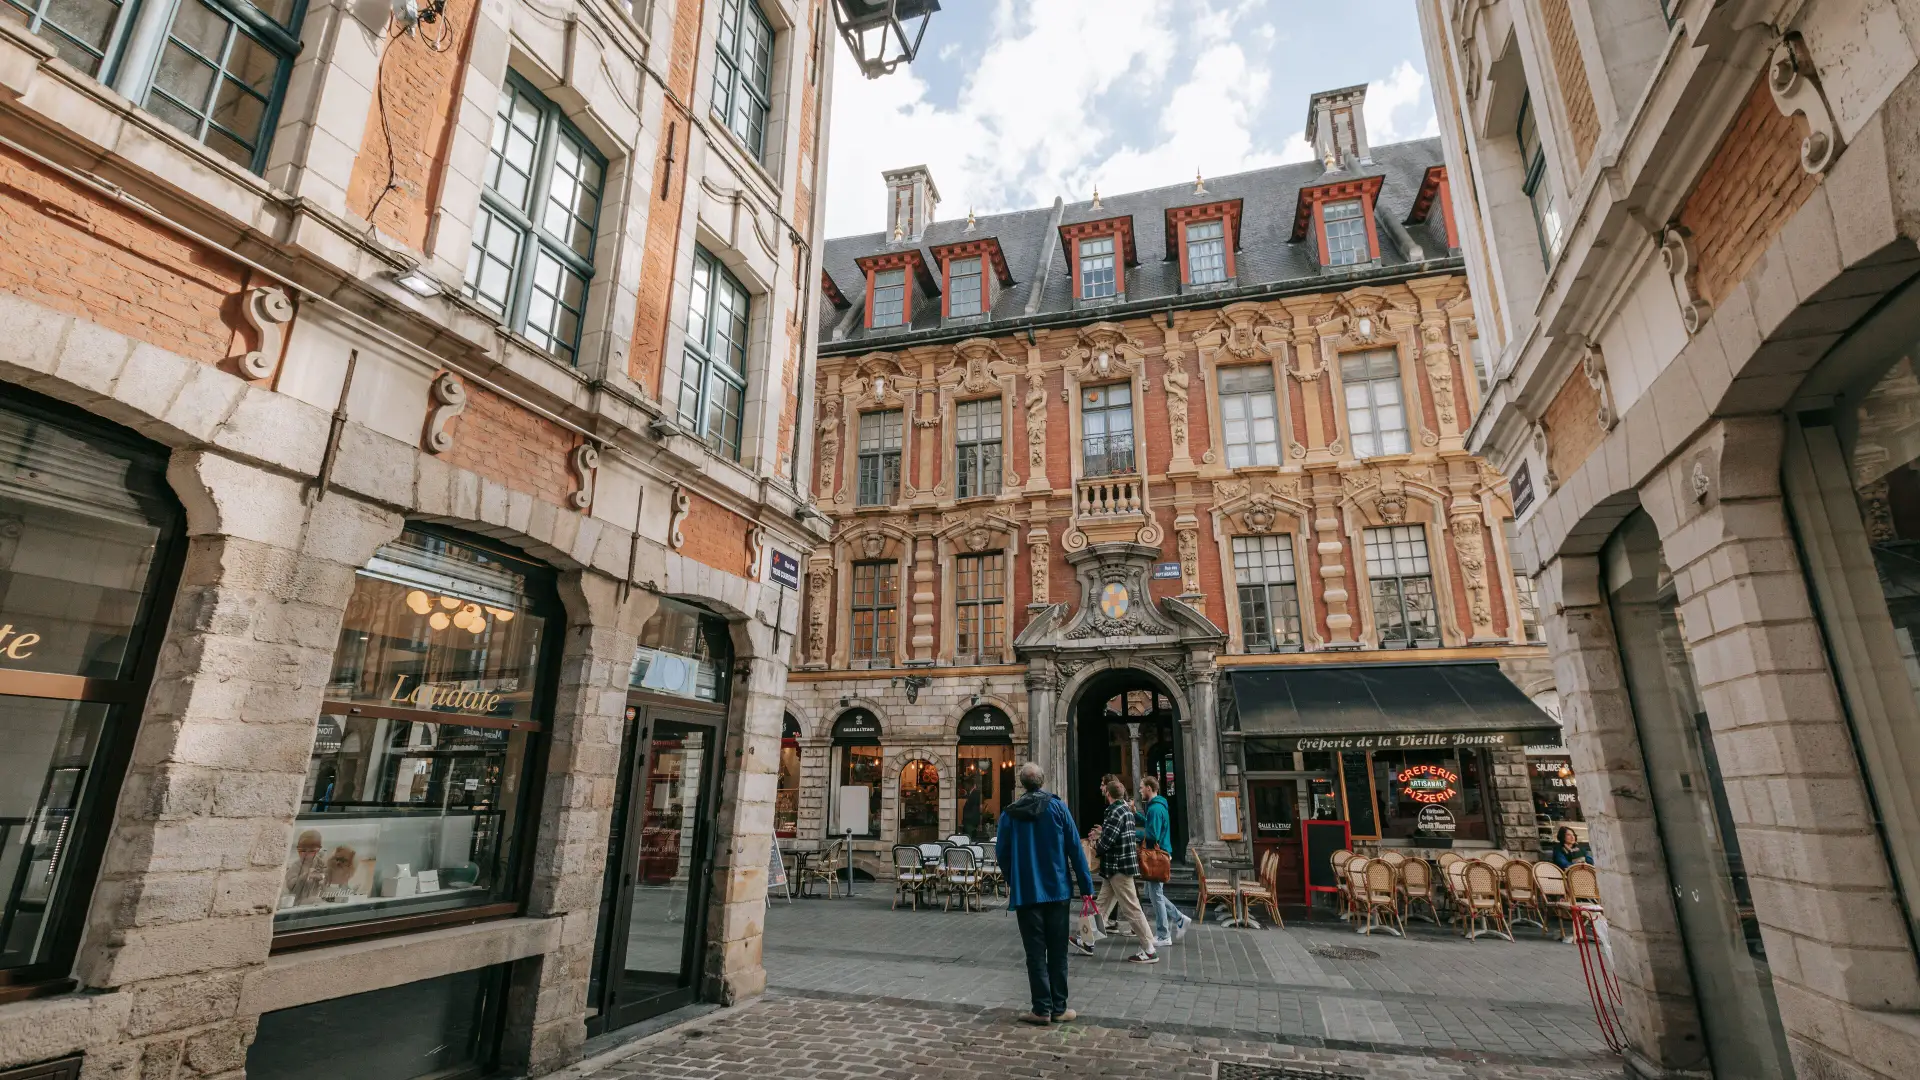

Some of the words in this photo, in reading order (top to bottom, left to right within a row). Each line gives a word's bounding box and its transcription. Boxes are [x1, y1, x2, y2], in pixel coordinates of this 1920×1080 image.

[390, 674, 500, 712] Laudate
[1296, 737, 1352, 751] Crêperie
[1356, 736, 1372, 748] de
[1378, 736, 1392, 746] la
[1396, 734, 1447, 746] Vieille
[1452, 734, 1504, 746] Bourse
[1536, 763, 1561, 772] SALADES
[1398, 765, 1458, 784] CREPERIE
[1410, 780, 1446, 788] ARTISANALE
[1551, 778, 1564, 787] TEA
[1404, 787, 1457, 803] PIZZERIA
[1558, 794, 1576, 802] HOME
